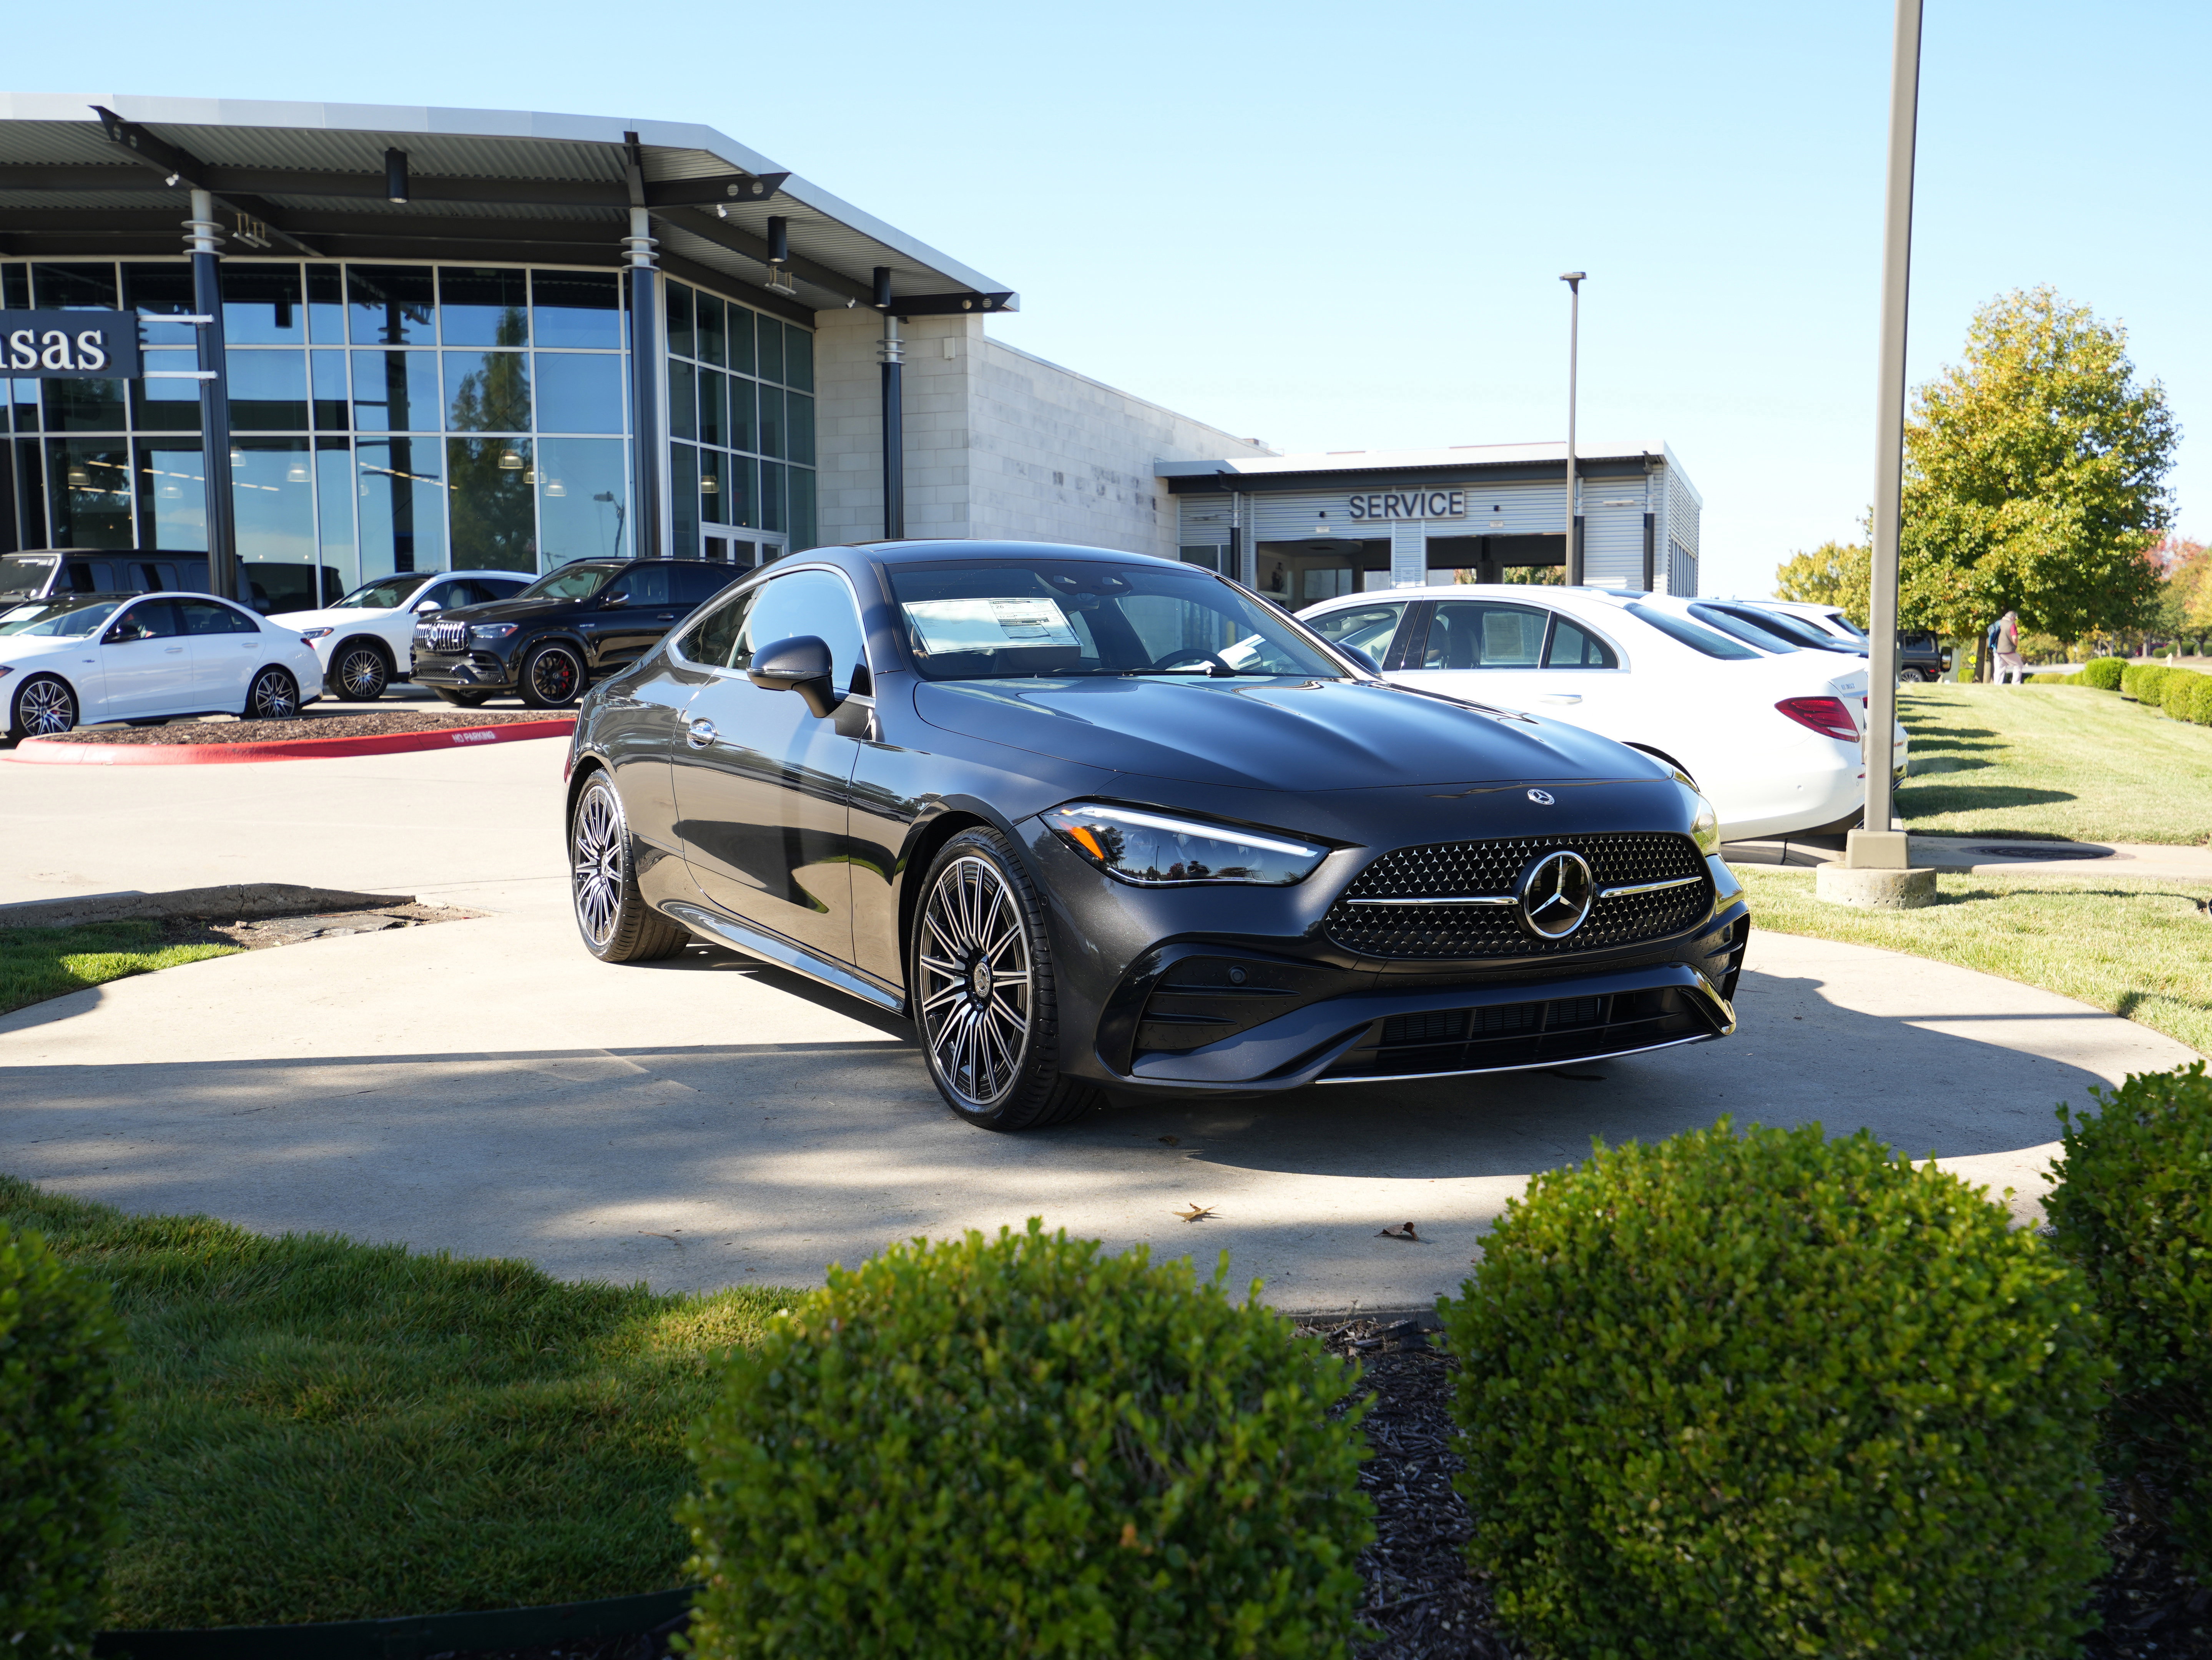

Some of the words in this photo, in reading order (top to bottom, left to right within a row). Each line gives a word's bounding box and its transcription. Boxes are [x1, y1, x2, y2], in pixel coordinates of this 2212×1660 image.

[0, 329, 105, 370] sas
[1349, 492, 1462, 519] SERVICE
[451, 734, 464, 743] NO
[463, 730, 496, 742] PARKING
